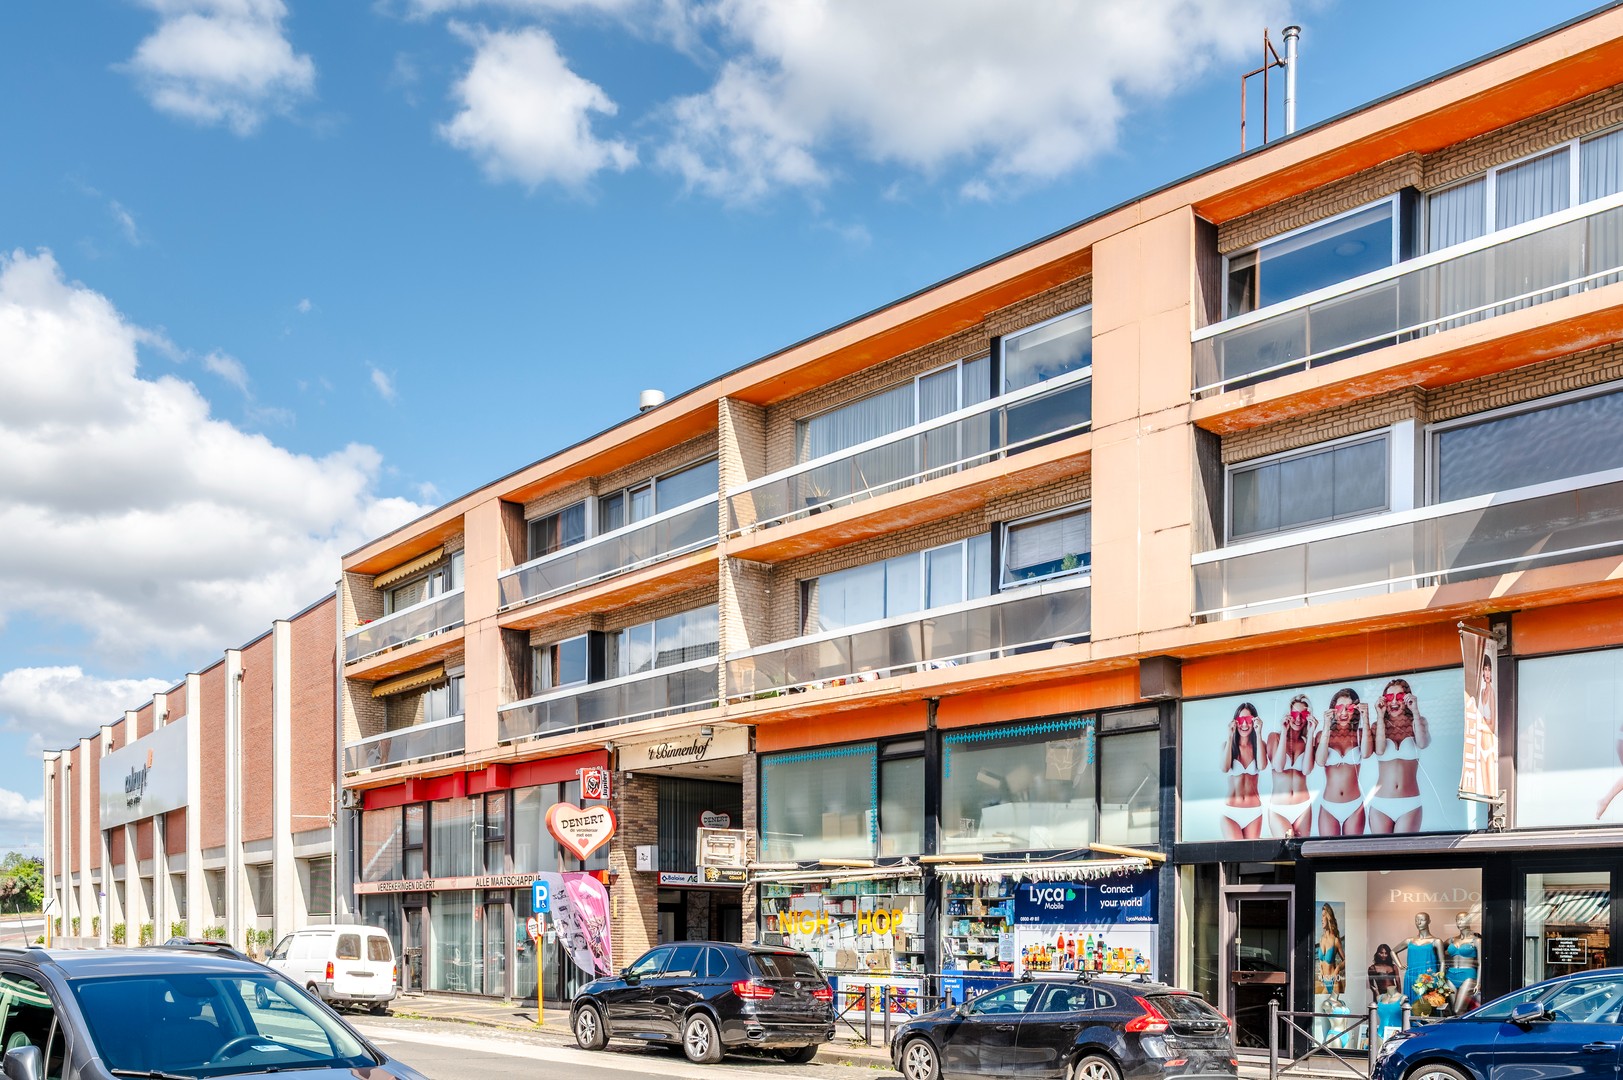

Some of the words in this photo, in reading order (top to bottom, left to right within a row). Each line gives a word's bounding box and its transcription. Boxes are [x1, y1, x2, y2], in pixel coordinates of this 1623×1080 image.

[656, 737, 713, 760] Binnenhof
[561, 814, 604, 829] DENERT
[377, 881, 415, 892] VERZEKERINGEN
[415, 880, 436, 890] DENERT
[475, 877, 490, 887] ALLE
[1100, 884, 1133, 893] Connect
[535, 885, 547, 908] P
[1029, 885, 1065, 905] Lyca
[1100, 899, 1119, 909] your
[1119, 897, 1142, 906] world
[779, 909, 829, 935] NIGH
[857, 908, 904, 935] HOP
